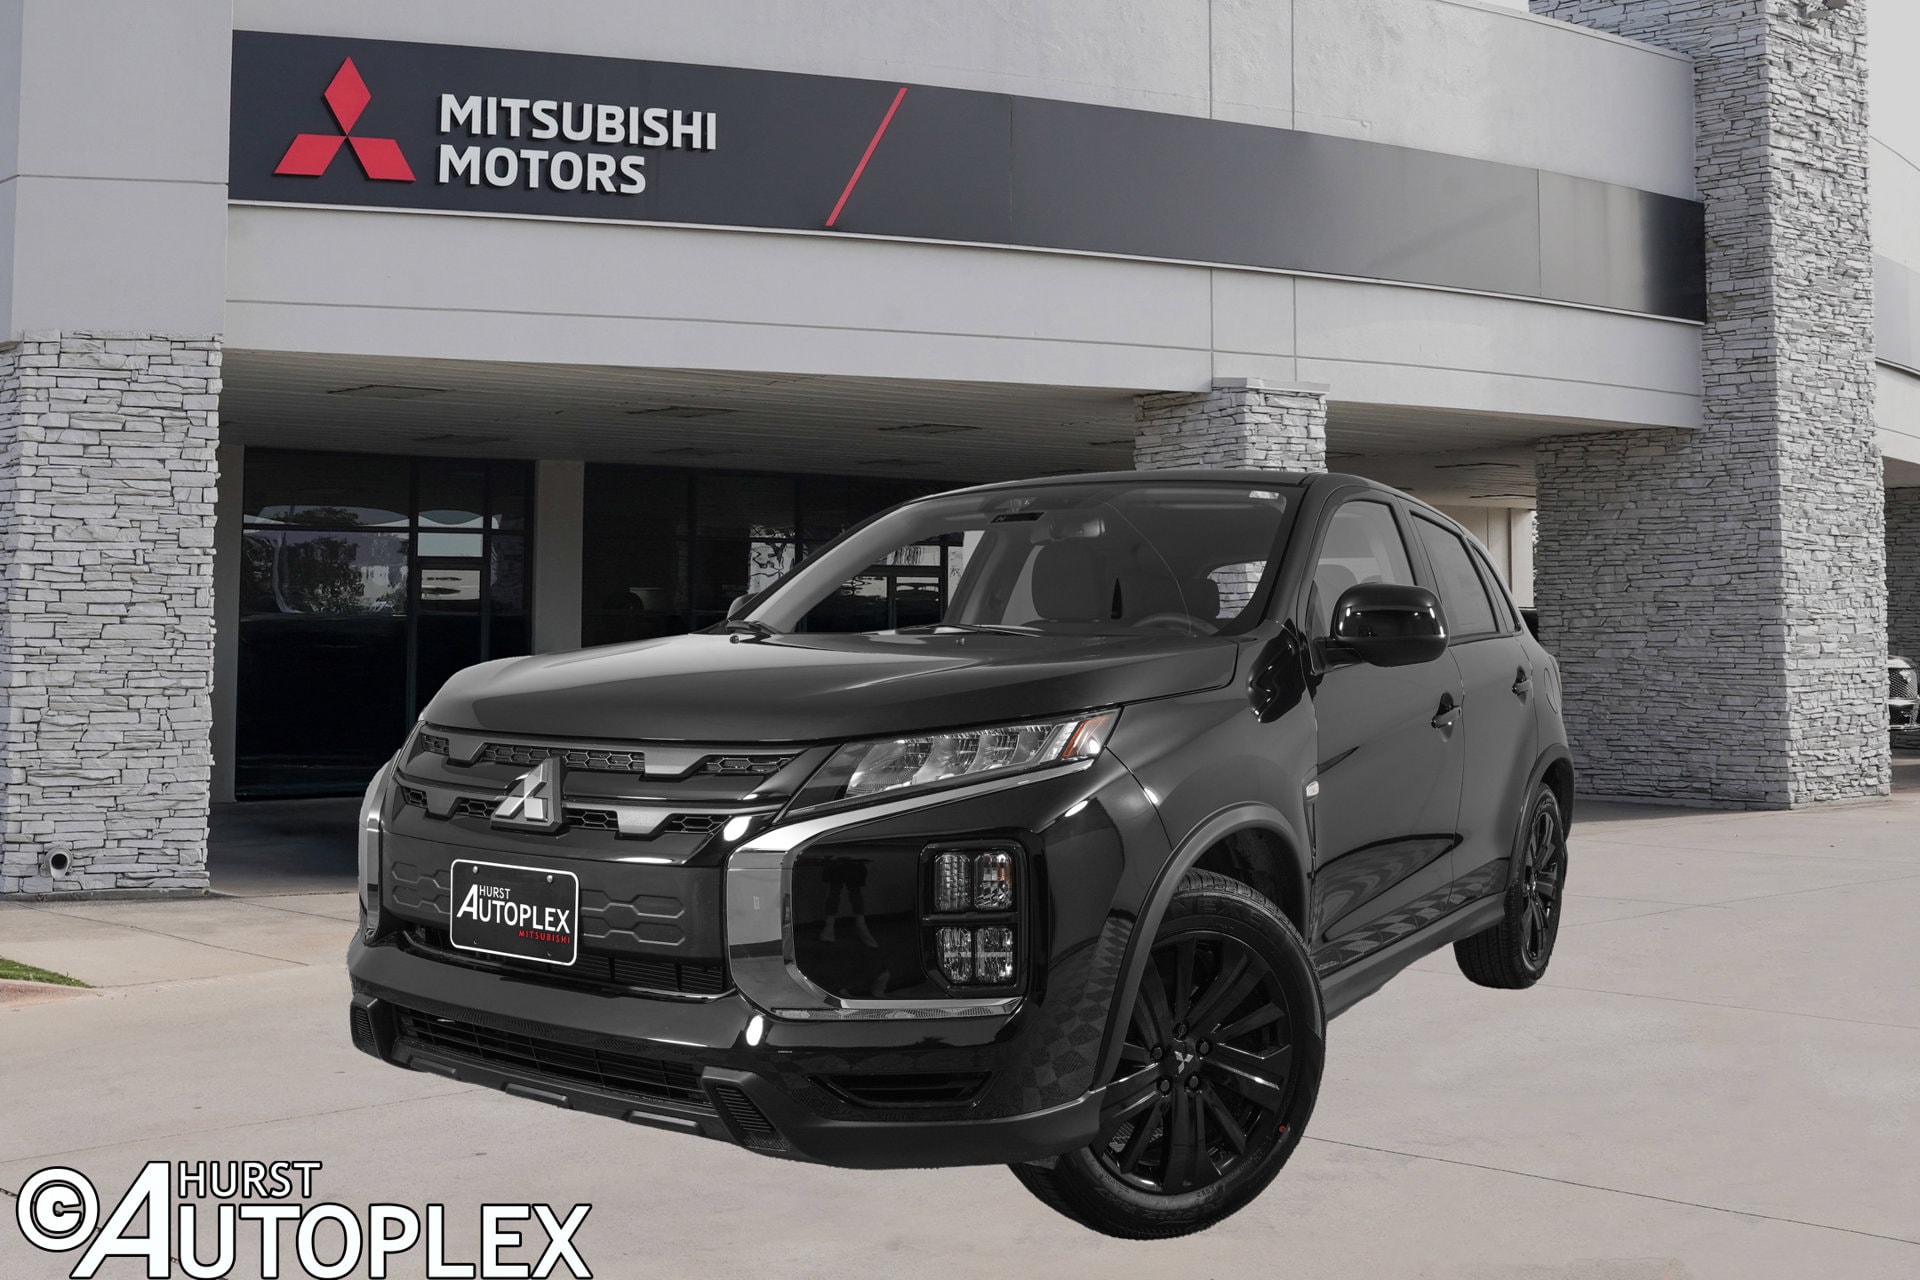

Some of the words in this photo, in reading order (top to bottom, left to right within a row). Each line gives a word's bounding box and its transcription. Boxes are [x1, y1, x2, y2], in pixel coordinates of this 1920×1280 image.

[440, 93, 717, 150] MITSUBISHI
[438, 144, 647, 194] MOTORS
[456, 884, 570, 934] AUTOPLEX
[479, 885, 511, 899] HURST
[518, 930, 571, 944] MITSUBISHI
